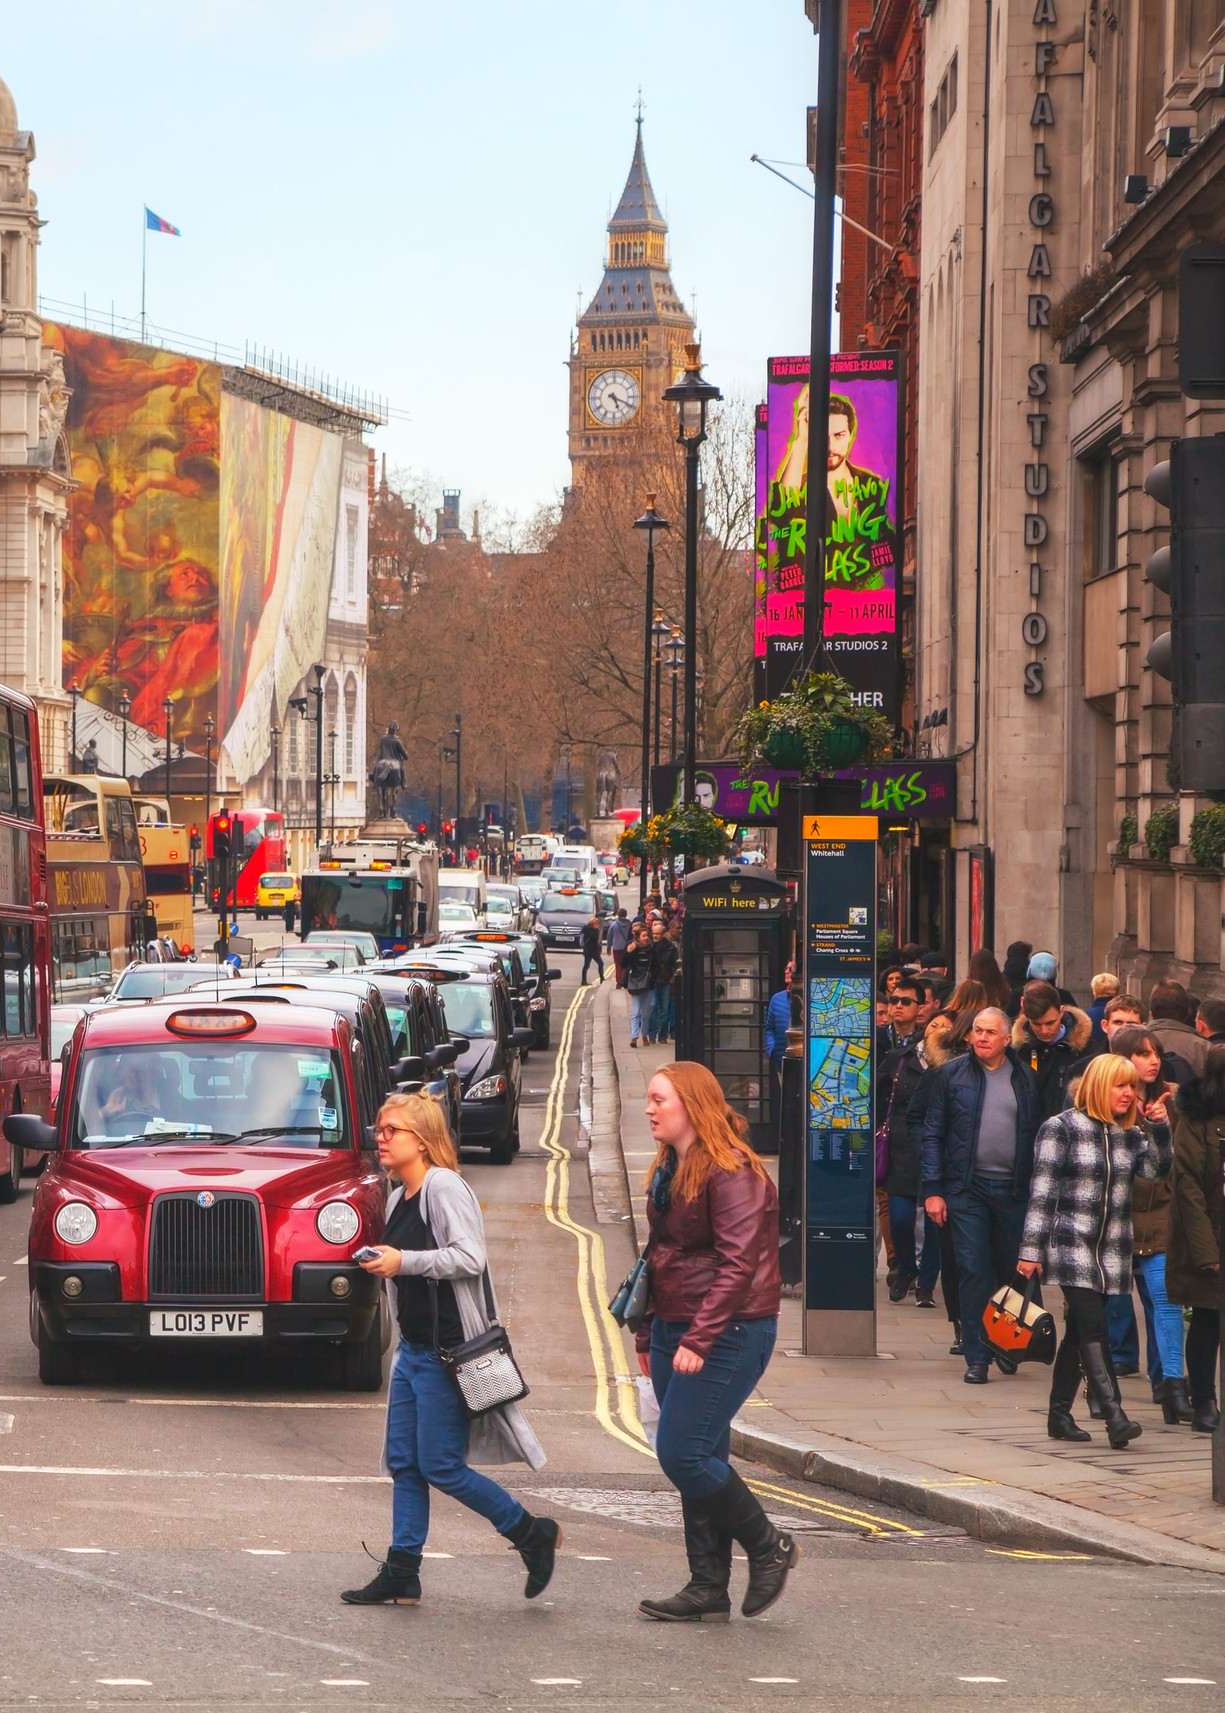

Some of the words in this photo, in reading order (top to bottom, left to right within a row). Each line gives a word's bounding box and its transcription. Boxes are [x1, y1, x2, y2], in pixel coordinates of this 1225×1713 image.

[772, 362, 810, 375] TRAFALGAR
[887, 359, 894, 370] 2
[770, 526, 790, 540] THE
[1022, 363, 1049, 696] STUDIOS
[825, 543, 871, 582] LASS
[769, 609, 780, 621] 16
[862, 603, 895, 619] APRIL
[834, 640, 879, 651] STUDIOS
[881, 640, 888, 651] 2
[702, 897, 727, 907] WiFi
[732, 897, 756, 908] here
[162, 1313, 206, 1332] LO13
[211, 1313, 250, 1332] PVF
